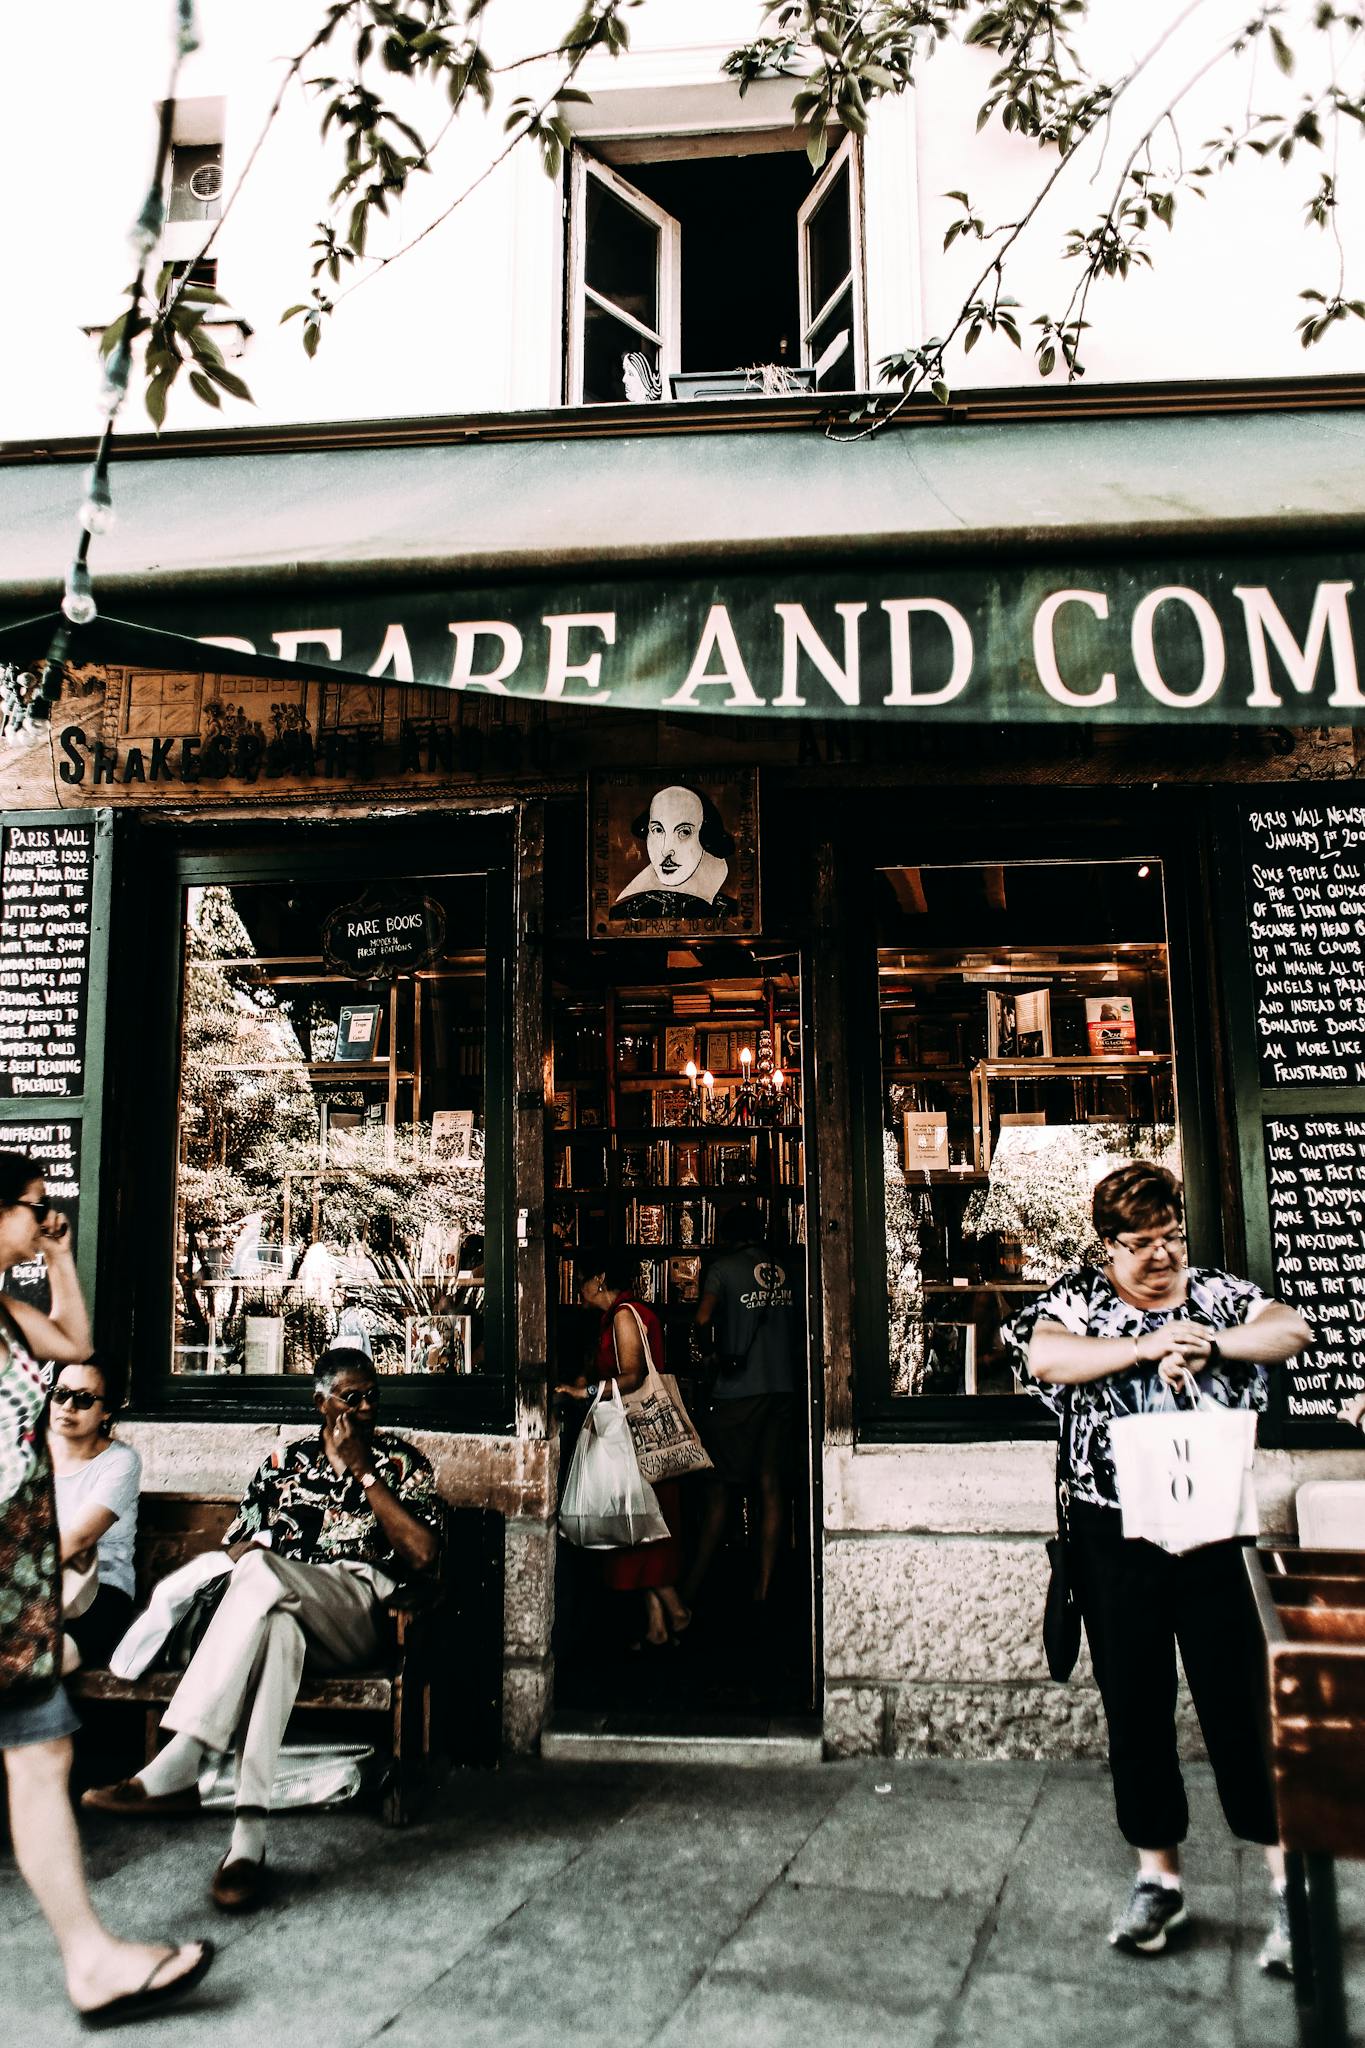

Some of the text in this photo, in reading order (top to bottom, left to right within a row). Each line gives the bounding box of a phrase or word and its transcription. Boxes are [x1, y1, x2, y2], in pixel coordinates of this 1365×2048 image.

[661, 597, 975, 707] AND
[1033, 580, 1365, 708] COM
[1248, 810, 1287, 832] PARIS
[1292, 807, 1323, 827] WALL
[10, 827, 90, 848] PARIS WALL
[1265, 831, 1320, 853] JANUARY
[1323, 830, 1338, 849] 1ST
[5, 849, 90, 865] NEWSPAPER 1999.
[1252, 863, 1360, 889] SOME PEOPLE CALL
[2, 882, 84, 899] WROTE ABOUT THE
[1264, 885, 1285, 901] THE
[1292, 884, 1321, 901] DON
[4, 902, 89, 918] LITTLE SHOPS OF
[1253, 902, 1267, 917] OF
[1271, 902, 1296, 918] THE
[1299, 903, 1337, 919] LATIN
[0, 922, 89, 938] THE LATIN QUARTER
[347, 913, 423, 937] RARE BOOKS
[1249, 921, 1297, 940] BECAUSE
[1300, 922, 1317, 940] MY
[1320, 921, 1350, 937] HEAD
[0, 937, 84, 953] WITH THEIR SHOP
[1253, 941, 1361, 961] UP IN THE CLOUDS
[35, 957, 62, 970] FILLED
[62, 957, 85, 969] WITH
[1255, 961, 1277, 976] CAN
[1283, 960, 1326, 975] IMAGINE
[1328, 960, 1350, 975] ALL
[0, 972, 81, 987] OLD BOOKS AND
[1265, 979, 1313, 995] ANGELS
[1318, 981, 1331, 995] IN
[43, 989, 78, 1005] WHERE
[1258, 999, 1284, 1014] AND
[1290, 999, 1335, 1014] INSTEAD
[1339, 997, 1352, 1012] OF
[28, 1009, 62, 1022] SEEMED
[65, 1008, 78, 1021] TO
[28, 1024, 50, 1037] AND
[53, 1024, 76, 1037] THE
[1257, 1017, 1318, 1035] BONAFIDE
[47, 1042, 75, 1055] COULD
[1263, 1040, 1362, 1059] AM MORE LIKE
[8, 1060, 35, 1073] SEEN
[37, 1059, 81, 1075] READING
[1273, 1062, 1347, 1082] FRUSTRATED
[56, 1125, 71, 1141] TO
[1266, 1121, 1299, 1141] THIS
[1305, 1122, 1341, 1137] STORE
[1268, 1142, 1356, 1160] LIKE CHAPTERS
[1270, 1167, 1297, 1184] AND
[1299, 1167, 1322, 1182] THE
[1325, 1164, 1353, 1182] FACT
[1270, 1188, 1297, 1206] AND
[1274, 1209, 1362, 1230] MORE REAL TO
[1274, 1232, 1290, 1256] MY
[1276, 1256, 1302, 1274] AND
[1308, 1256, 1339, 1272] EVEN
[1280, 1277, 1293, 1296] IS
[1295, 1280, 1318, 1296] THE
[1321, 1277, 1344, 1294] FACT
[1318, 1304, 1350, 1322] BORN
[1321, 1327, 1345, 1345] THE
[1286, 1355, 1299, 1370] IN
[1303, 1351, 1315, 1367] A
[1315, 1351, 1347, 1369] BOOK
[1335, 1373, 1365, 1390] AND
[1288, 1395, 1337, 1416] READING
